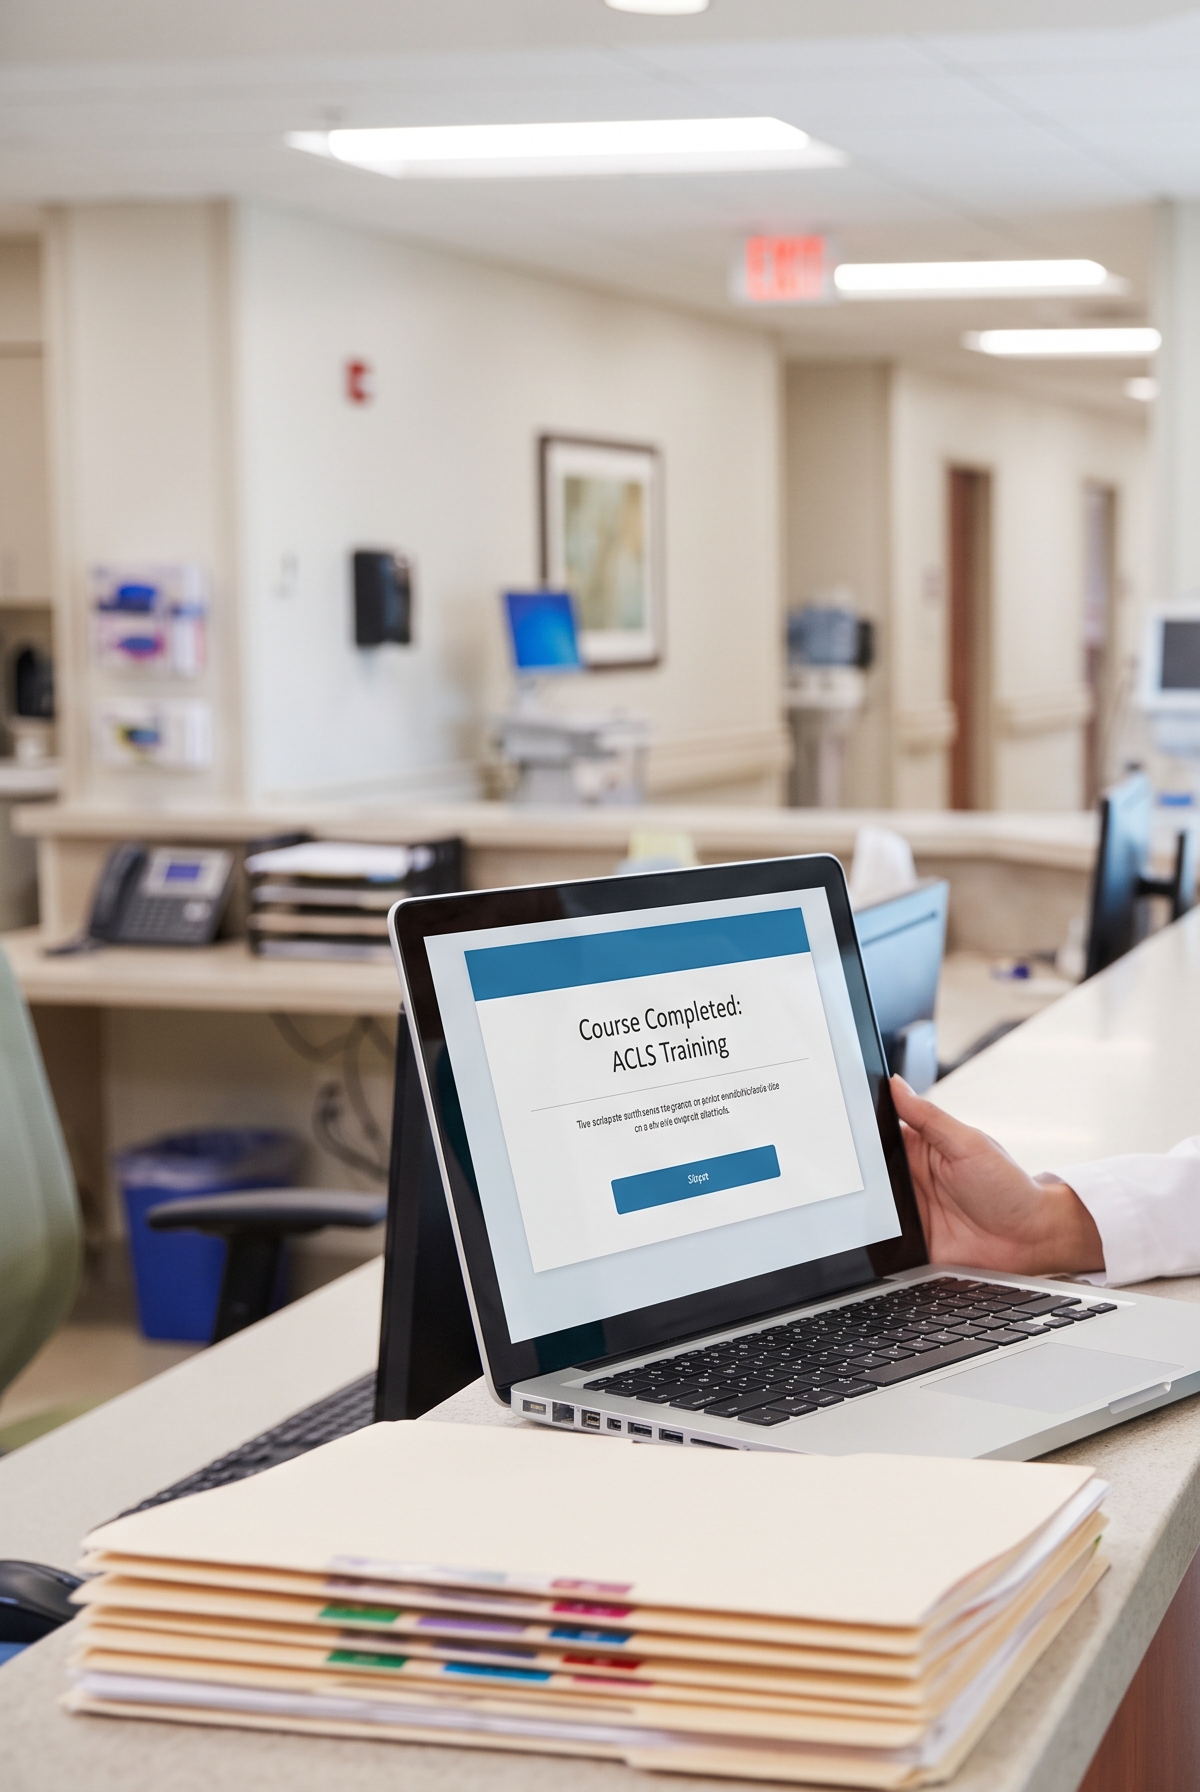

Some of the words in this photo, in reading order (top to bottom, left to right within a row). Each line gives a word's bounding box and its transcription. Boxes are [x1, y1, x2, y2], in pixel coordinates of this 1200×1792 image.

[578, 1016, 641, 1041] Course
[644, 994, 743, 1029] Completed:
[613, 1044, 657, 1073] ACLS
[659, 1035, 730, 1063] Training
